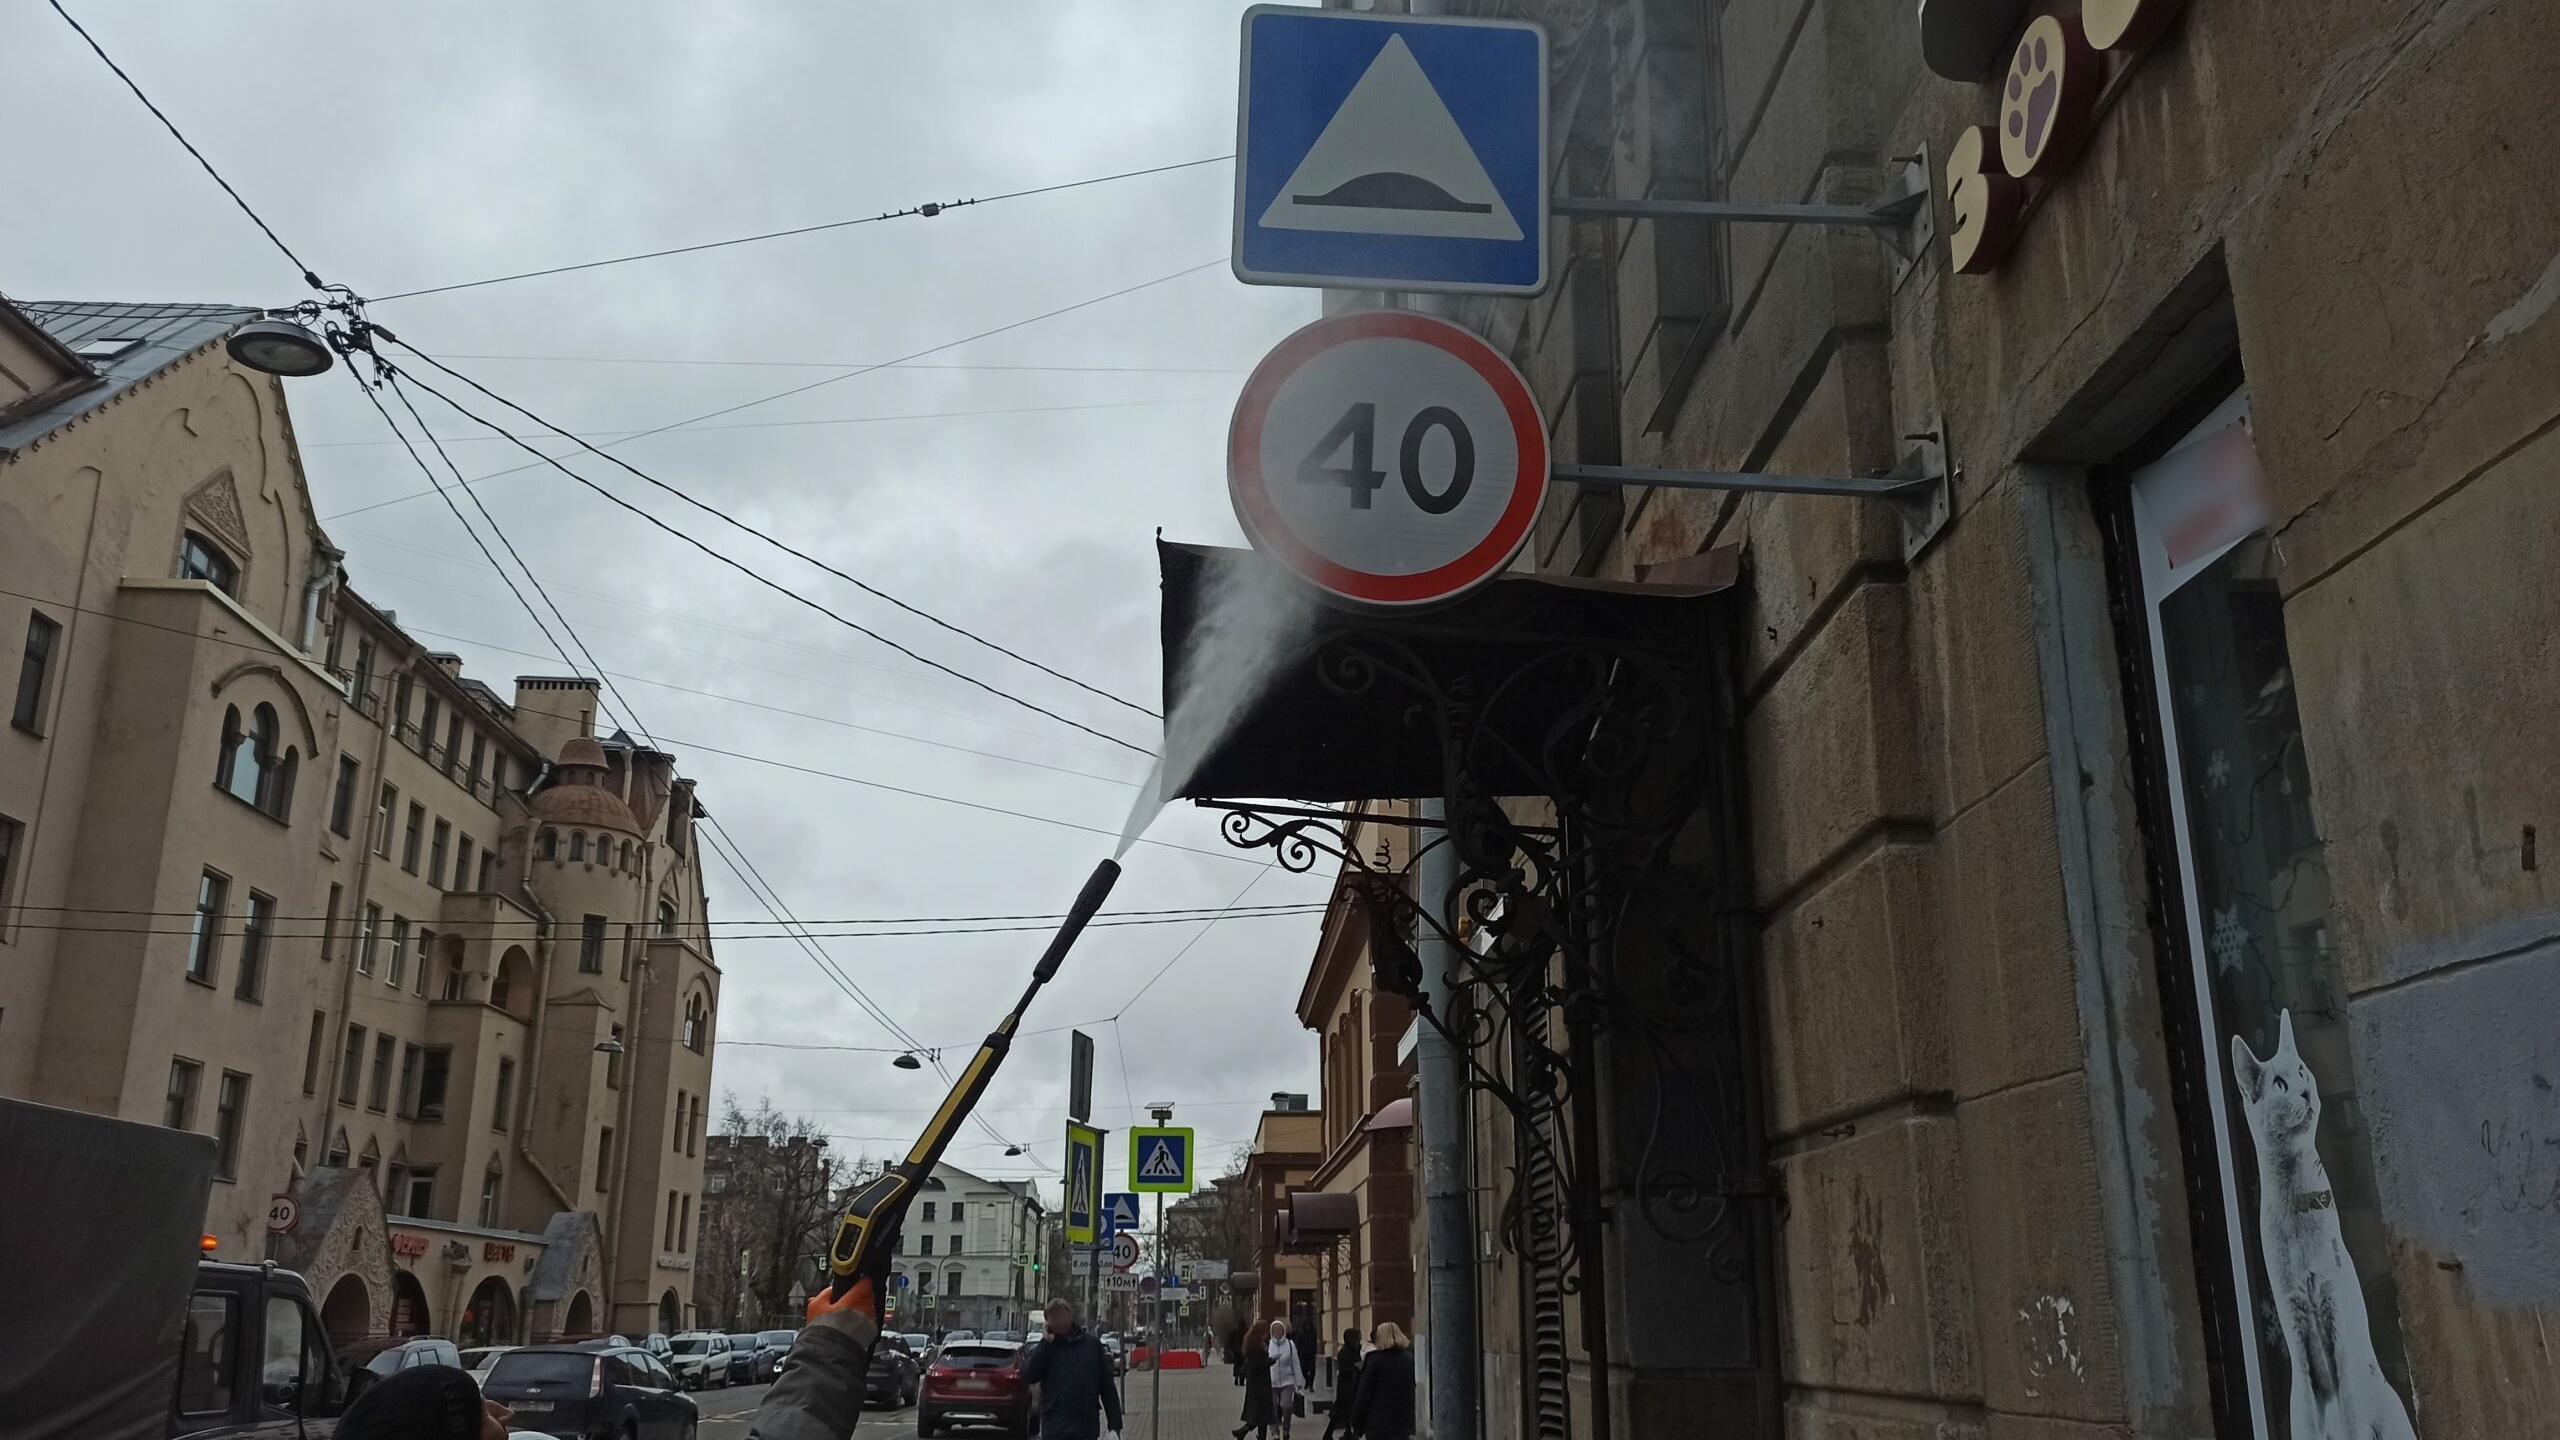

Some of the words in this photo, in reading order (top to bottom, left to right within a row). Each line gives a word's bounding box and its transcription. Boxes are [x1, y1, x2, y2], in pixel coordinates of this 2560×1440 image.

[1296, 402, 1475, 515] 40
[269, 1206, 289, 1220] 40
[1113, 1245, 1131, 1259] 40
